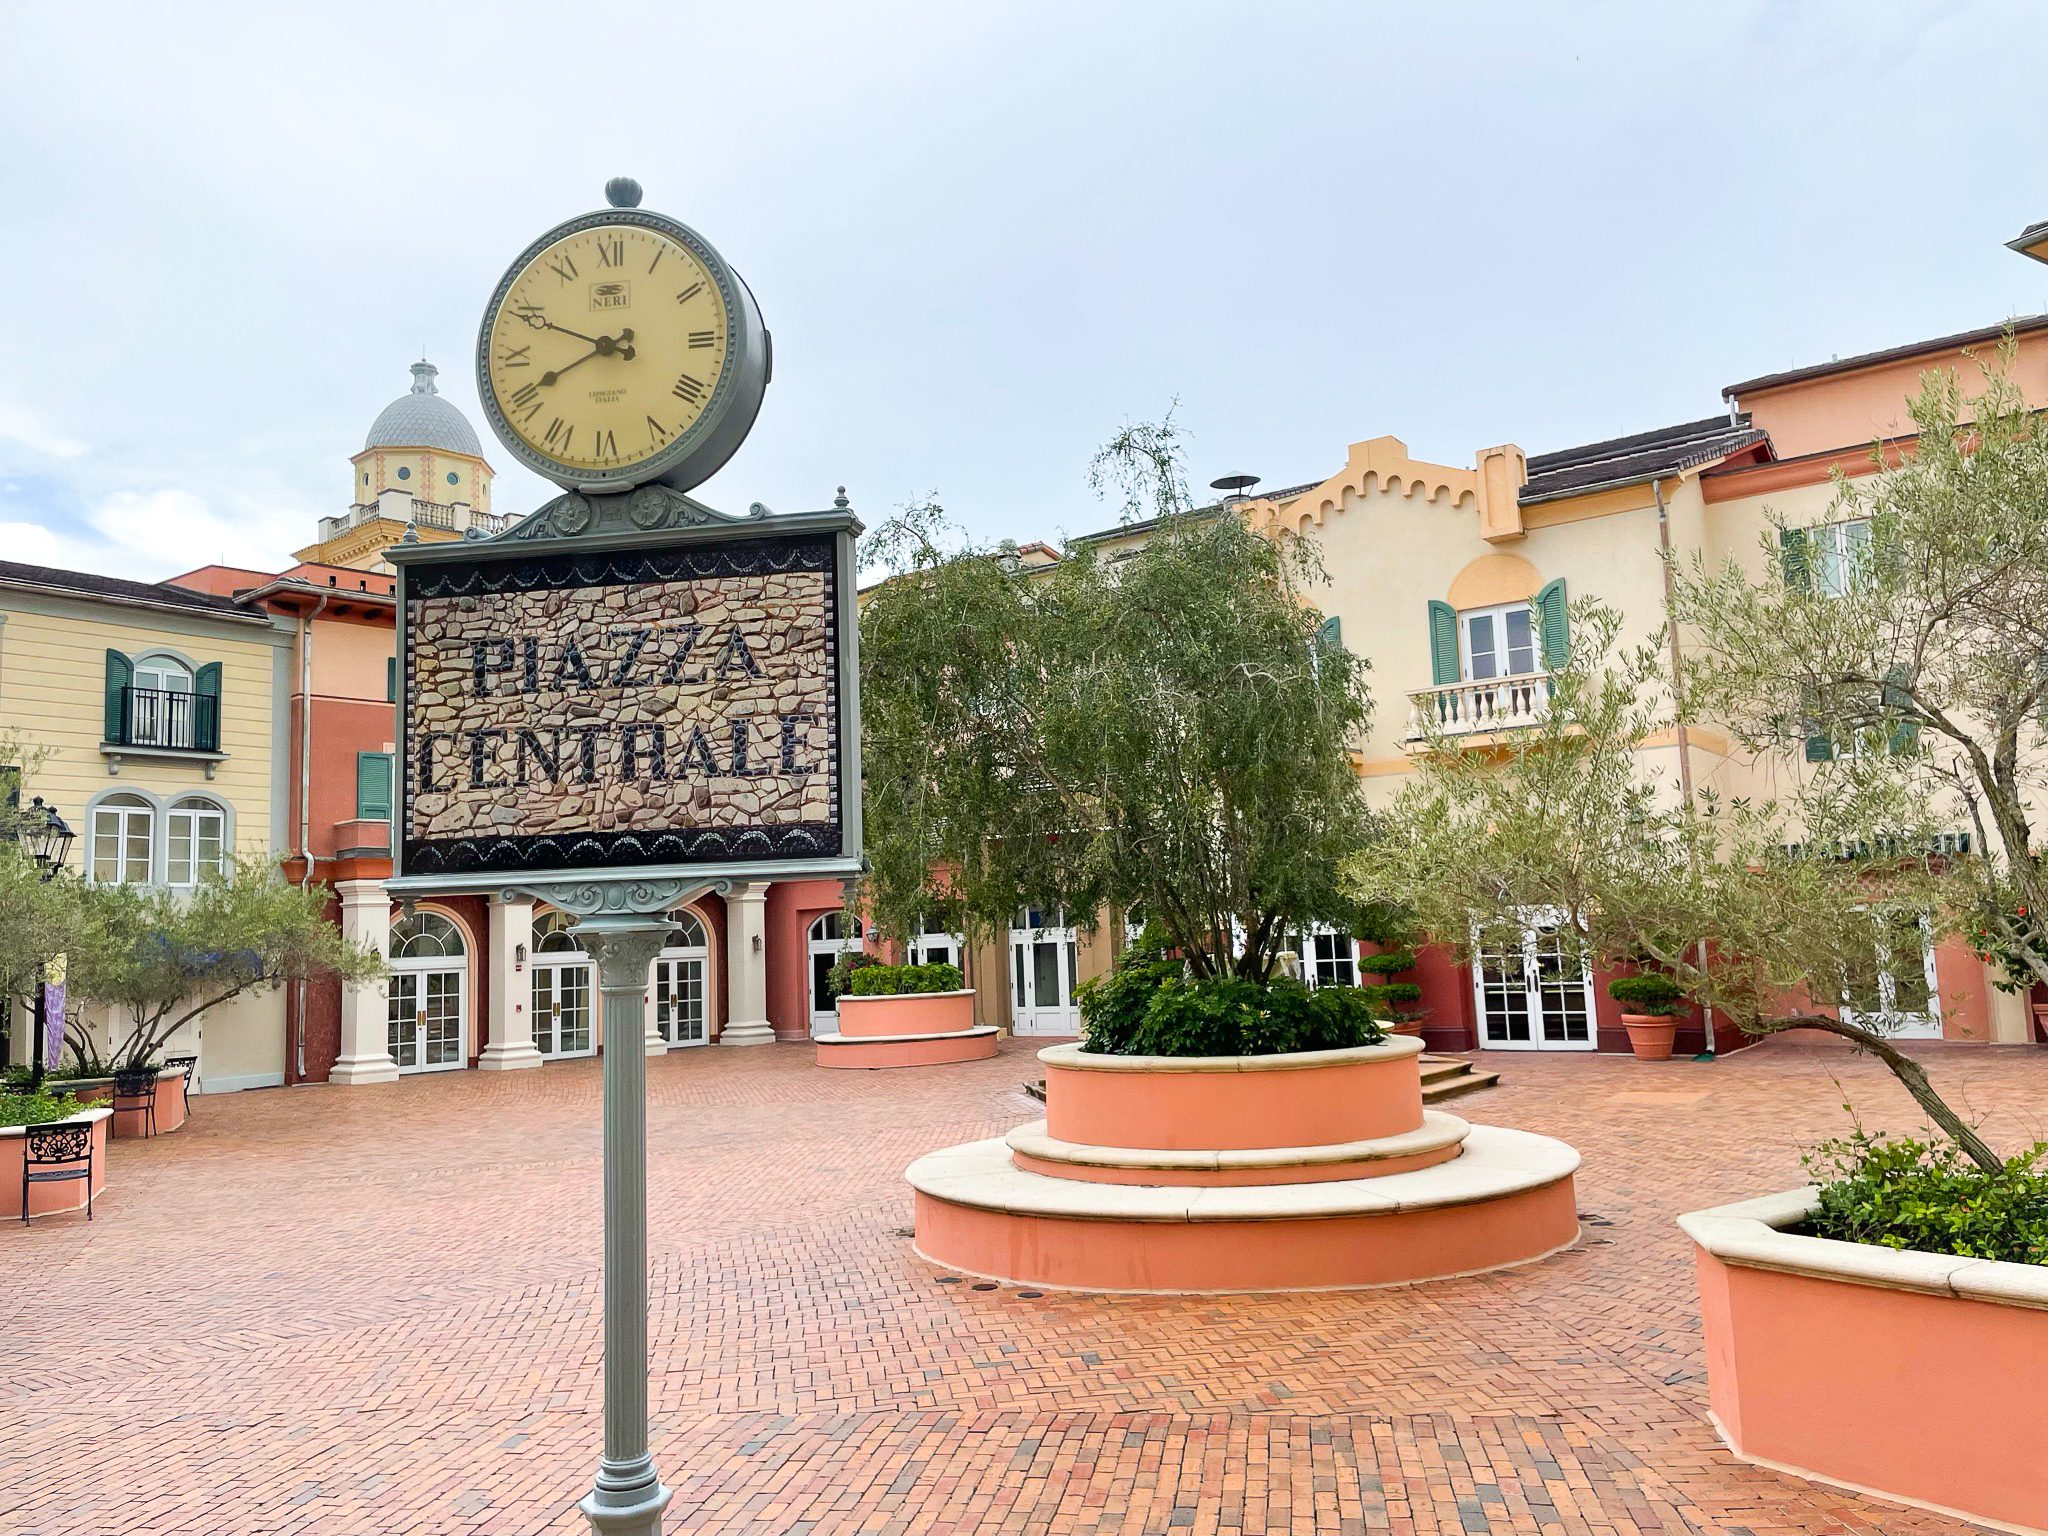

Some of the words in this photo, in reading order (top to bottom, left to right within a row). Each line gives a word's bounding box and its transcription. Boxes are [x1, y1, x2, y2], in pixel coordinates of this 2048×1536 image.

[597, 240, 624, 269] XII
[550, 255, 579, 288] XI
[592, 294, 627, 309] NERI
[676, 282, 703, 305] II
[688, 330, 715, 349] III
[504, 345, 531, 368] IX
[595, 395, 620, 404] ITALIA
[671, 373, 705, 405] IIII
[543, 416, 574, 452] VII
[646, 415, 667, 442] V
[596, 429, 618, 458] VI
[469, 624, 770, 698] PIAZZA
[420, 714, 820, 794] CENTRALE
